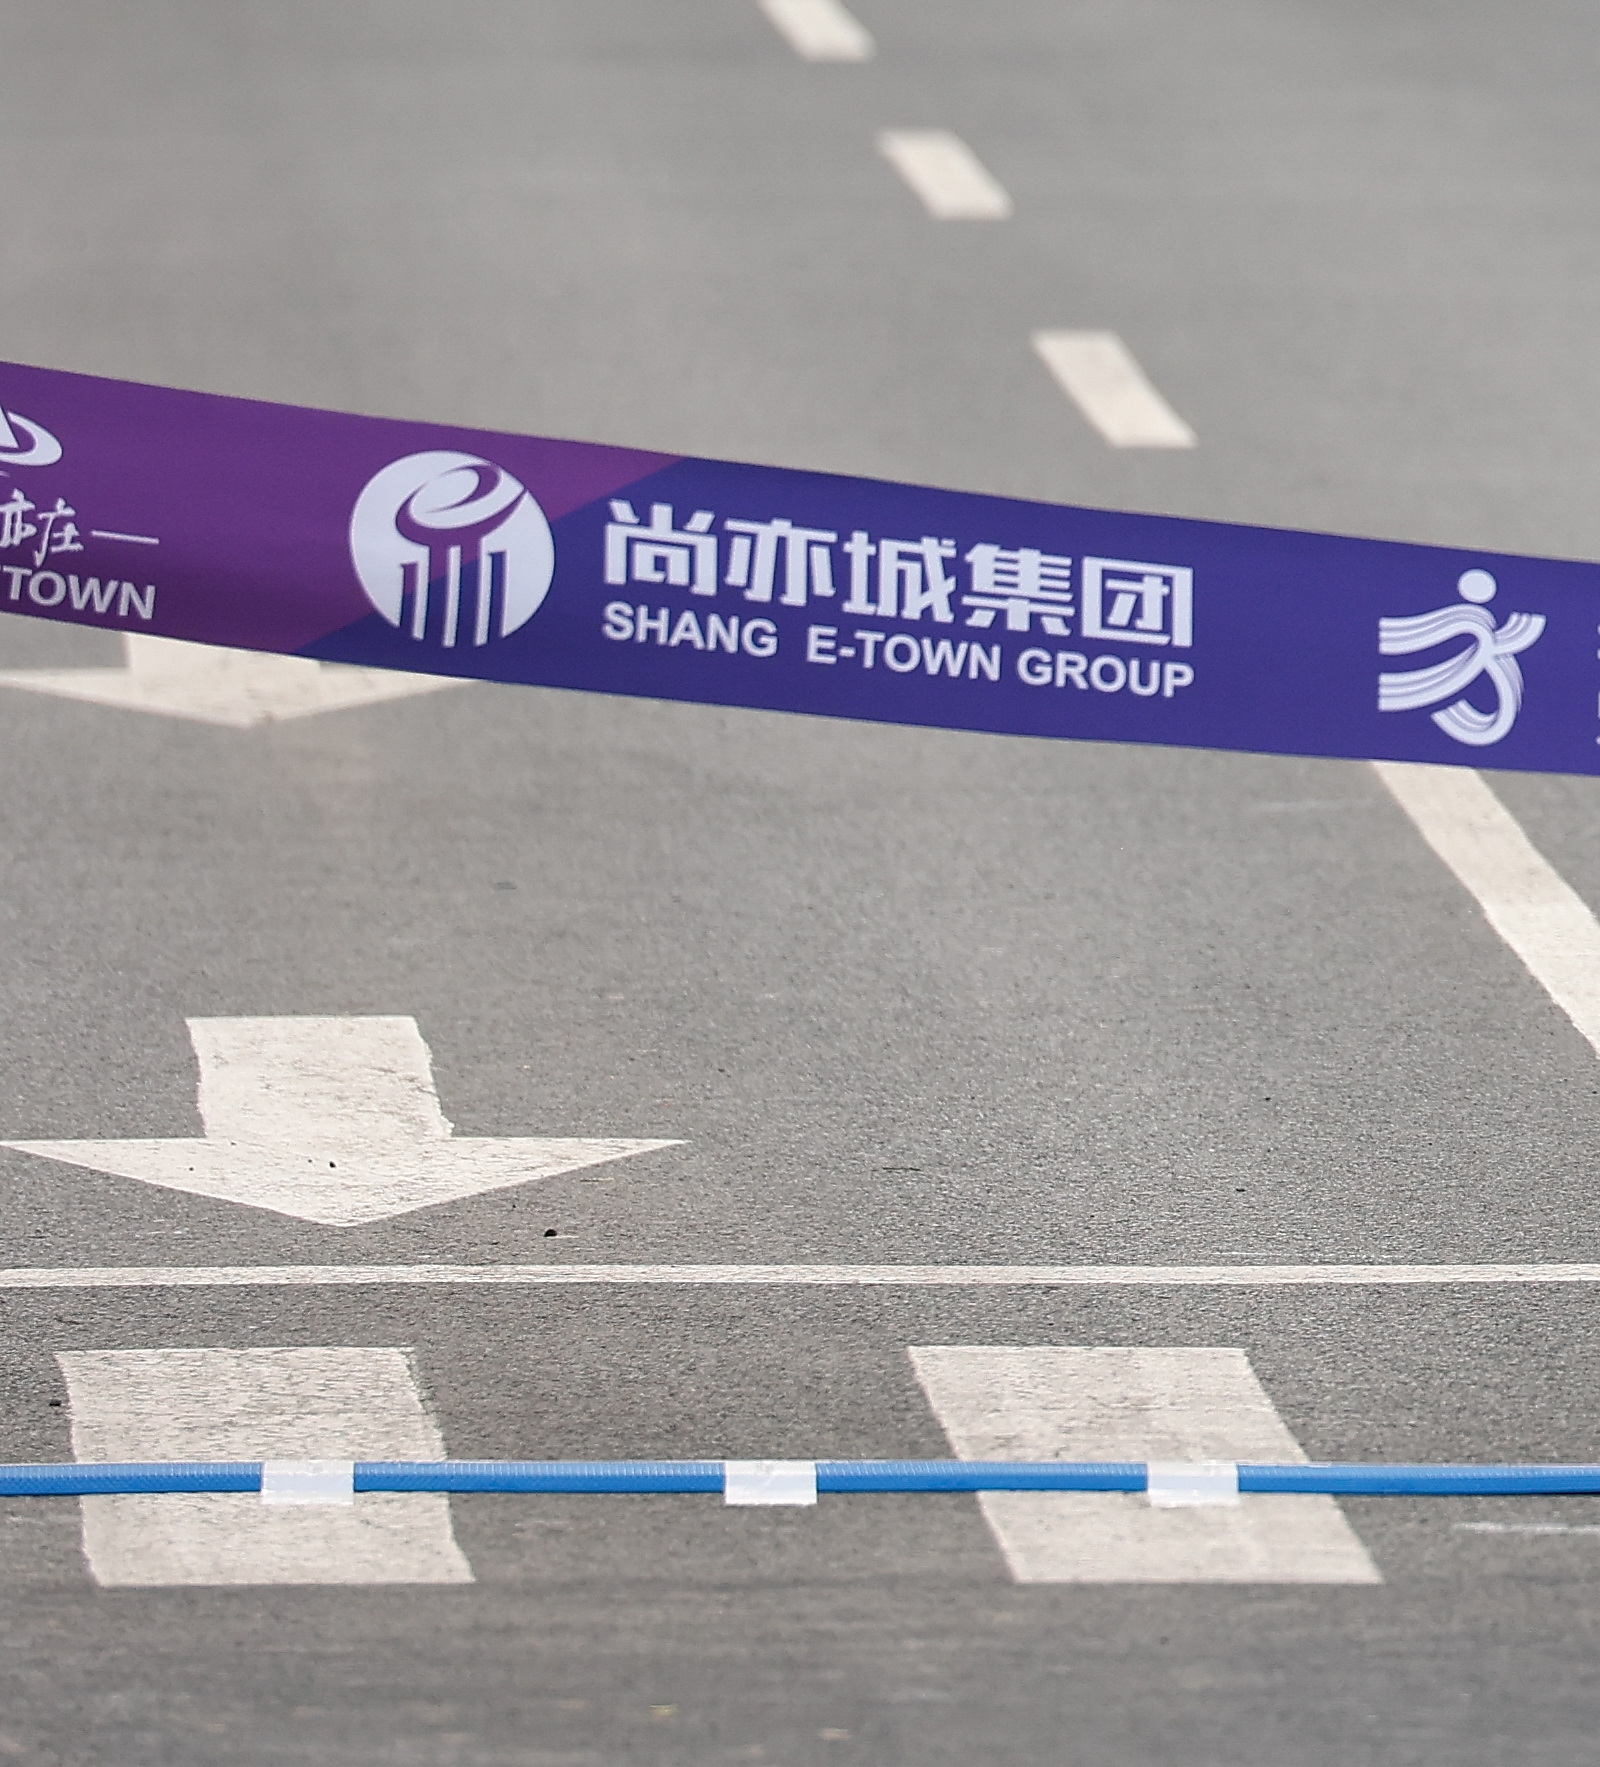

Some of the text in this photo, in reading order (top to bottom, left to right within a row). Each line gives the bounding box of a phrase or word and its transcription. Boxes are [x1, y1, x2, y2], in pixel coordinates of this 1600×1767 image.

[602, 499, 1194, 648] 尚亦城集团
[603, 601, 1194, 698] SHANG E-TOWN GROUP
